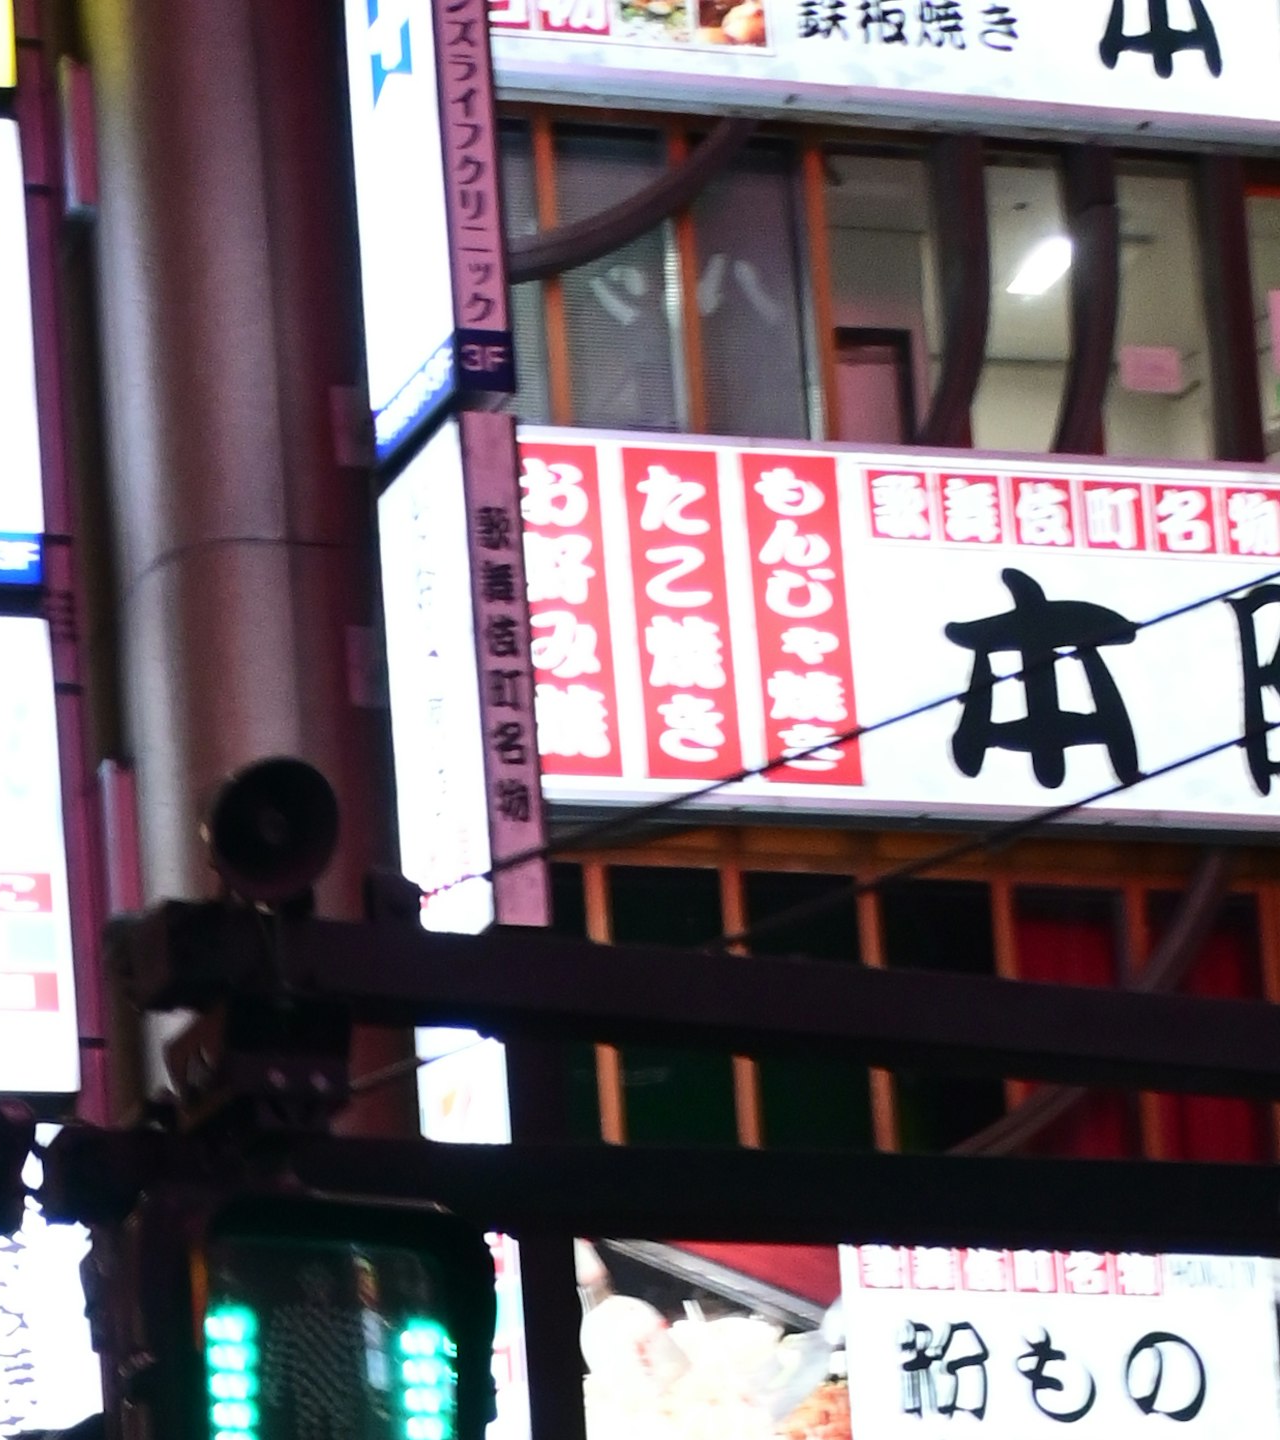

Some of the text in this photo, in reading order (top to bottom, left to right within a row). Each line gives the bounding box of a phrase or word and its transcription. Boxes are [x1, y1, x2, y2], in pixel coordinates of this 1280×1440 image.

[446, 0, 494, 323] ズライフクリニック
[461, 342, 506, 373] 3F
[636, 465, 726, 762] たこ焼き
[871, 473, 1280, 556] 歌舞伎町名物
[753, 467, 848, 771] もんじゃ焼き
[898, 1319, 1206, 1422] 粉もの
